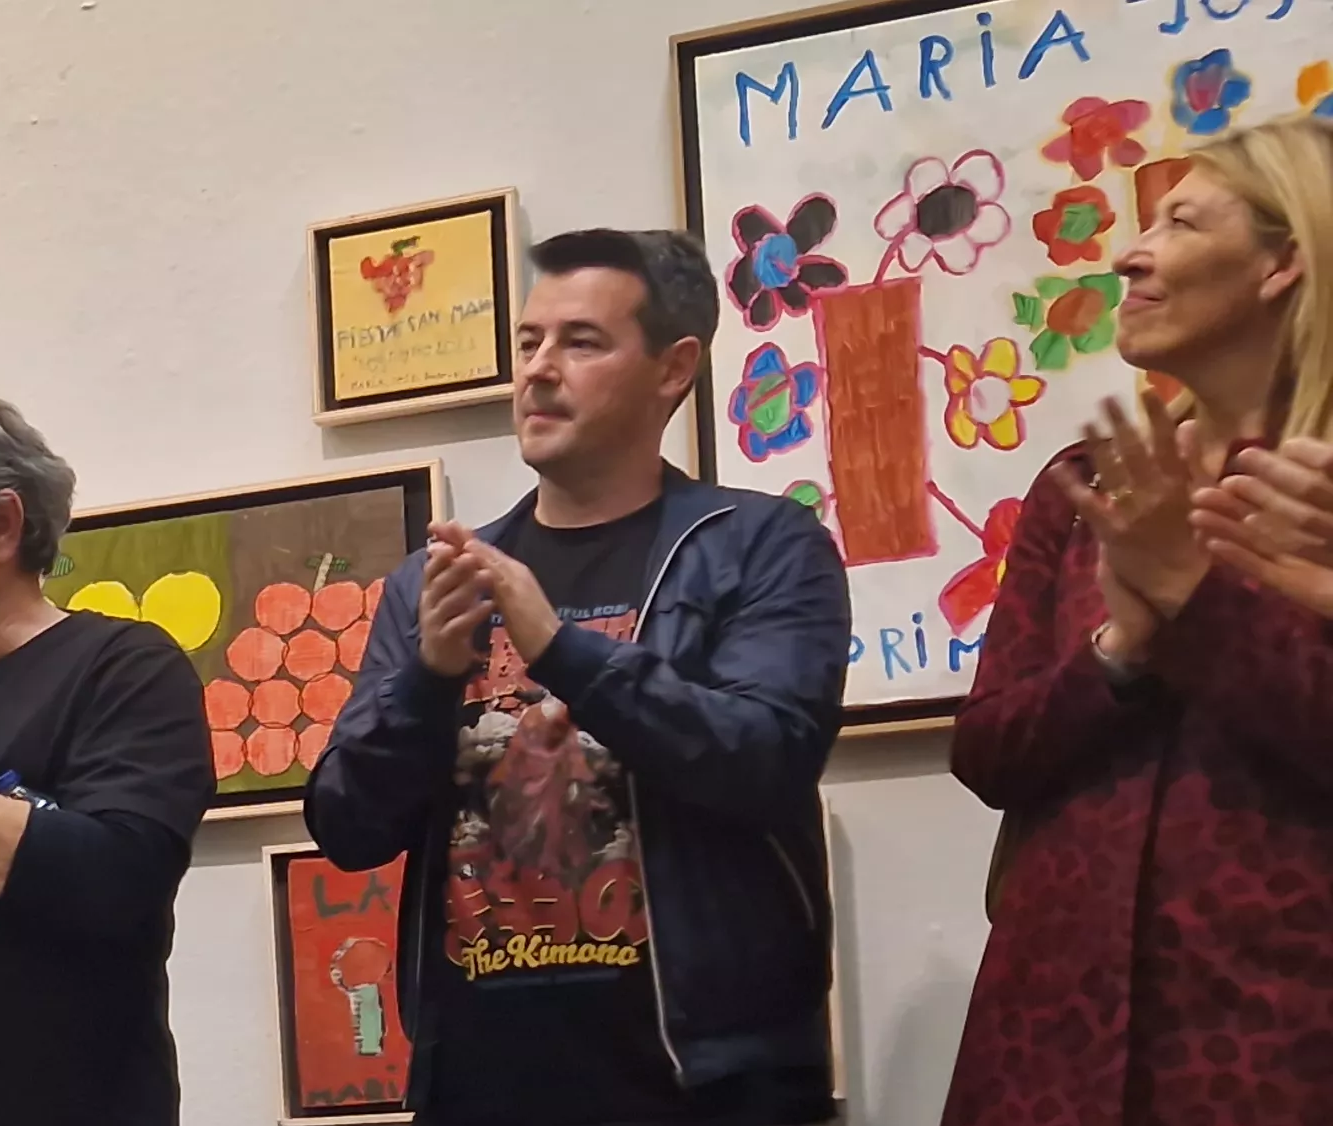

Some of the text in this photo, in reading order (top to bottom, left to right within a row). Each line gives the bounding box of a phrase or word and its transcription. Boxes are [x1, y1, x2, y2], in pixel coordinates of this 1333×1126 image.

[313, 871, 392, 919] LA
[462, 938, 510, 981] The
[507, 935, 641, 969] Kimono
